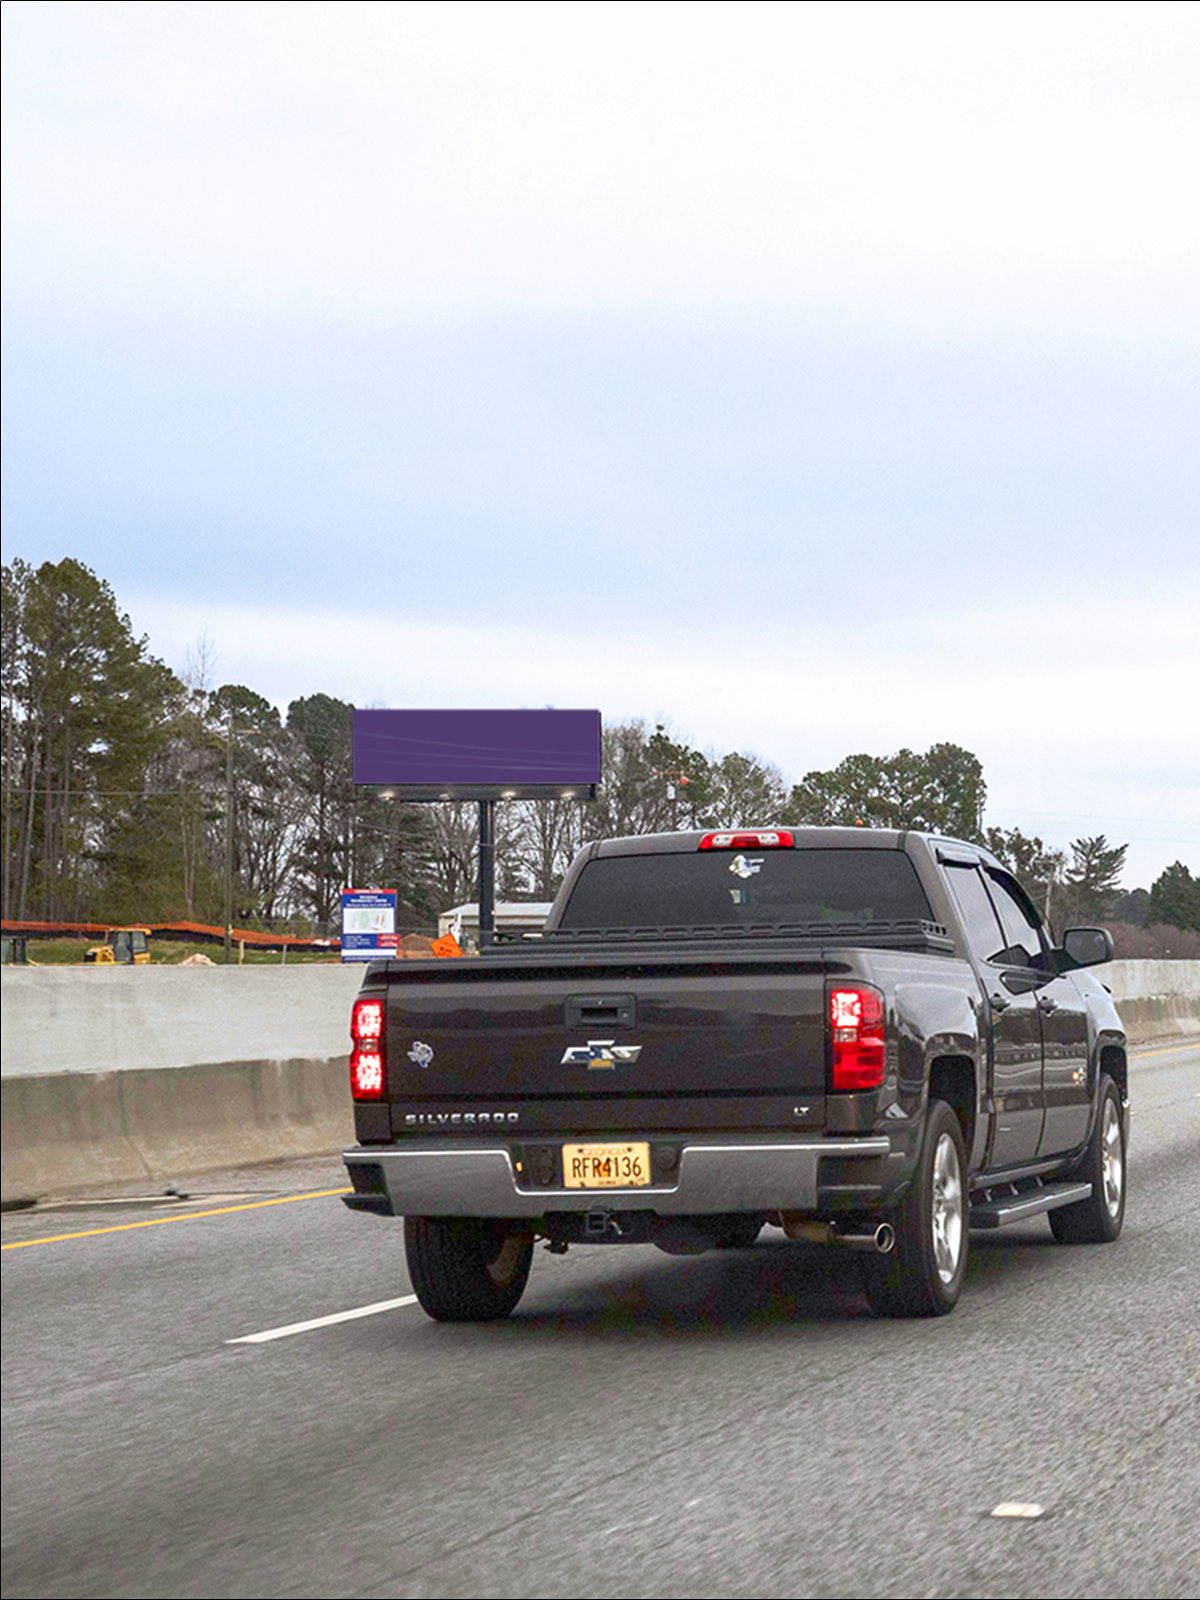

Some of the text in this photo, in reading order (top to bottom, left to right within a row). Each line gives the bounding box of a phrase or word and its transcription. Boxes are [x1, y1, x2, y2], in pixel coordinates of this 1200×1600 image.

[793, 1106, 809, 1117] LT
[405, 1112, 519, 1125] SILVERADO
[572, 1156, 642, 1178] RFR4136
